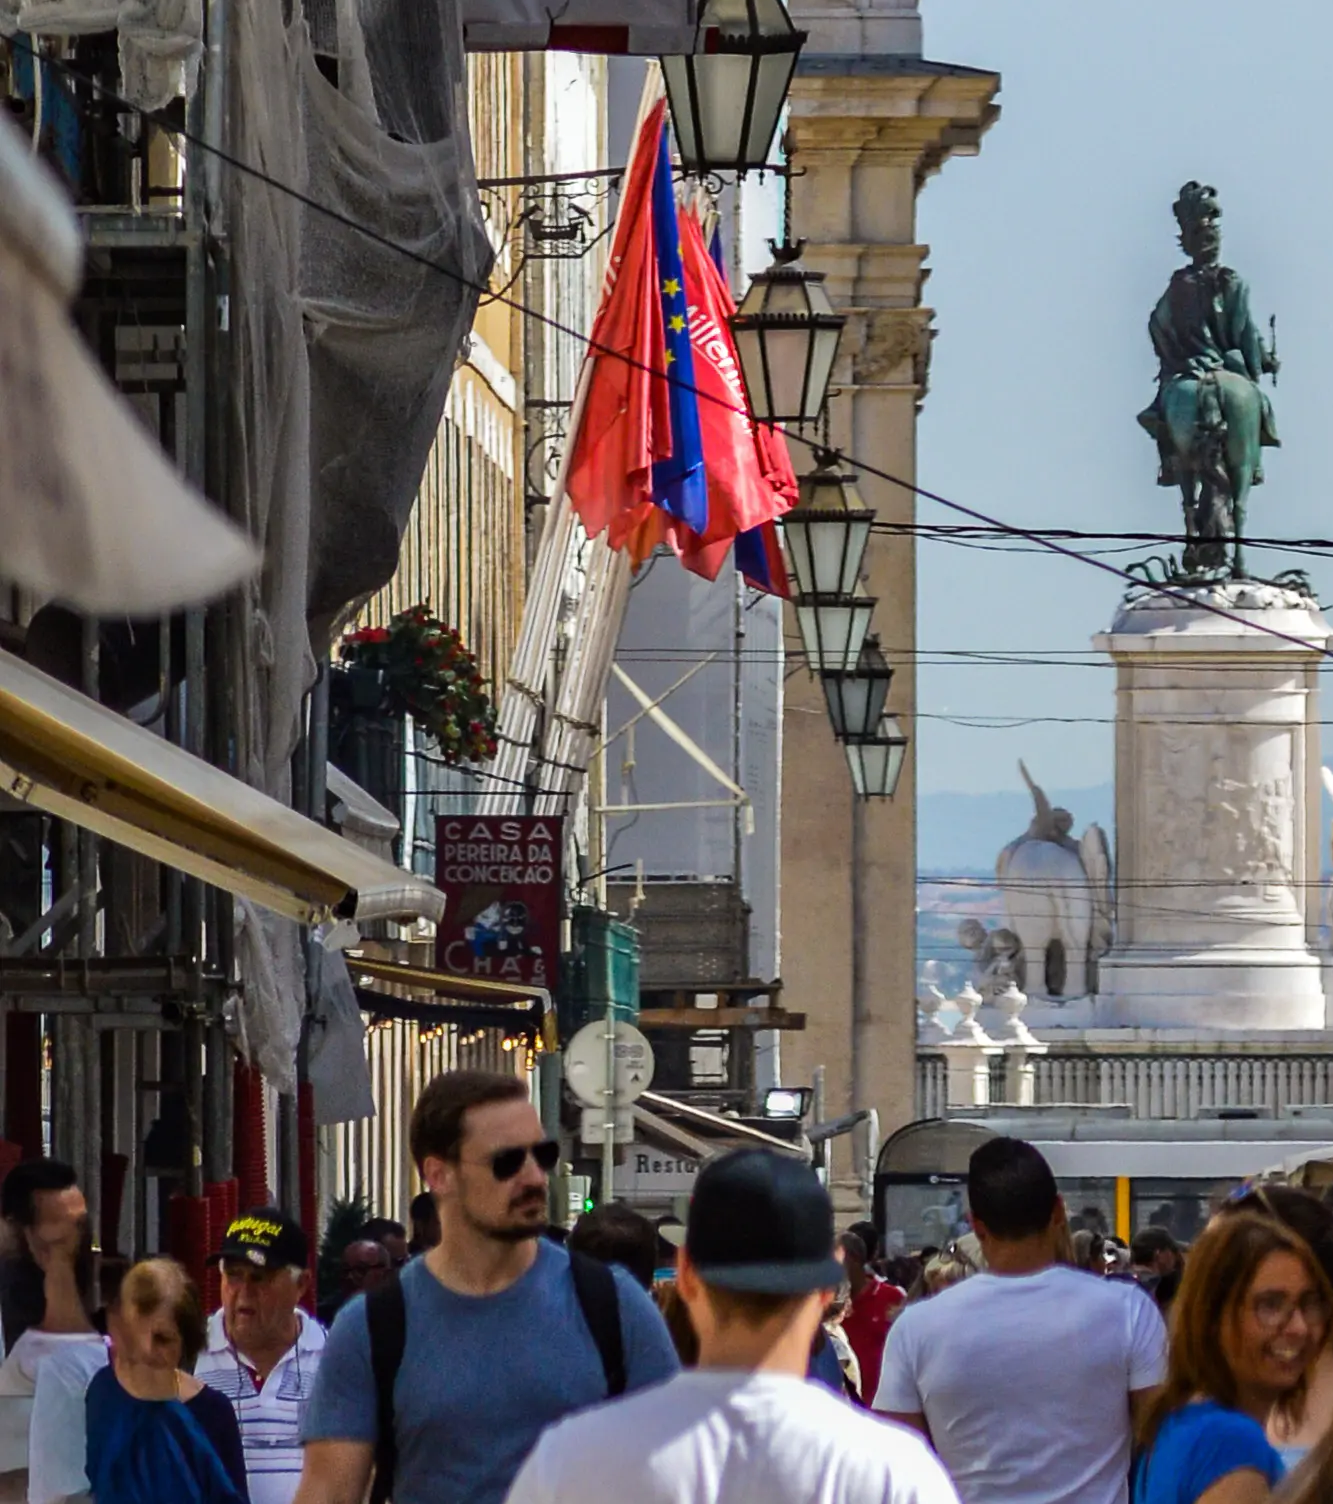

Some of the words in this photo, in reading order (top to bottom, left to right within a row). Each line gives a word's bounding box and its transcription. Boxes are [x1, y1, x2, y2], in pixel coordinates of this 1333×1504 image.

[444, 822, 553, 841] CASA
[444, 844, 523, 863] PEREIRA
[528, 844, 553, 863] DA
[444, 864, 554, 884] CONCEIÇÃO
